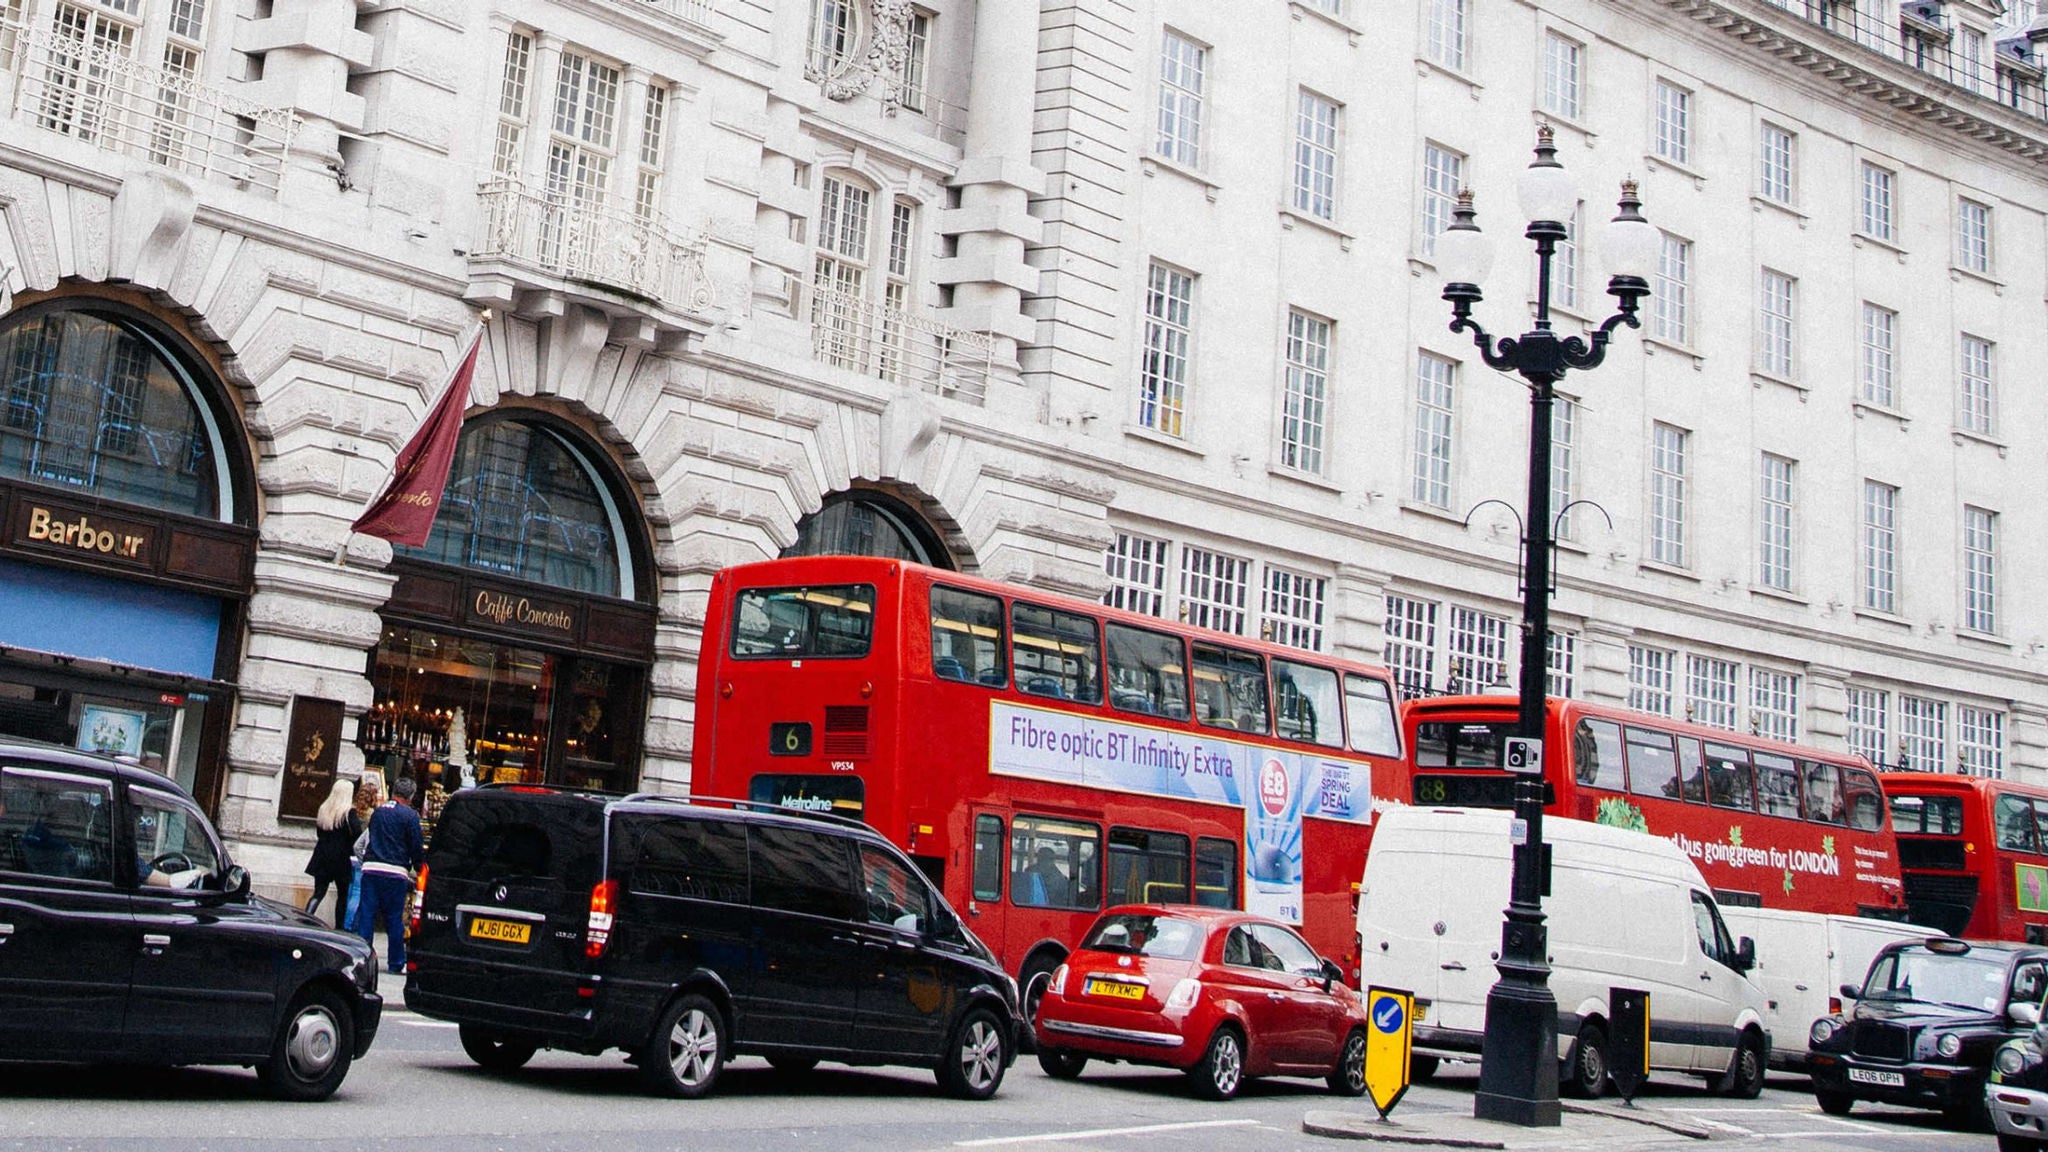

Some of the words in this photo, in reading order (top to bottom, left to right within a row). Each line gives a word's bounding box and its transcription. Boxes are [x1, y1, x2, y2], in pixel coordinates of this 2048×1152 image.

[28, 507, 144, 559] Barbour
[517, 598, 571, 630] Concerto
[786, 727, 799, 750] 6
[1011, 716, 1056, 751] Fibre
[1061, 729, 1103, 760] optic
[1107, 732, 1128, 762] BT
[1132, 736, 1190, 777] Infinity
[1194, 746, 1232, 778] Extra
[831, 761, 855, 771] VPS34
[1264, 764, 1285, 797] £8
[1321, 778, 1351, 793] SPRING
[1420, 780, 1445, 802] 88
[781, 794, 832, 811] Metroline
[1321, 790, 1350, 810] DEAL
[1681, 832, 1702, 858] bus
[1769, 847, 1788, 869] for
[1789, 849, 1840, 877] LONDON
[502, 924, 525, 939] GGX
